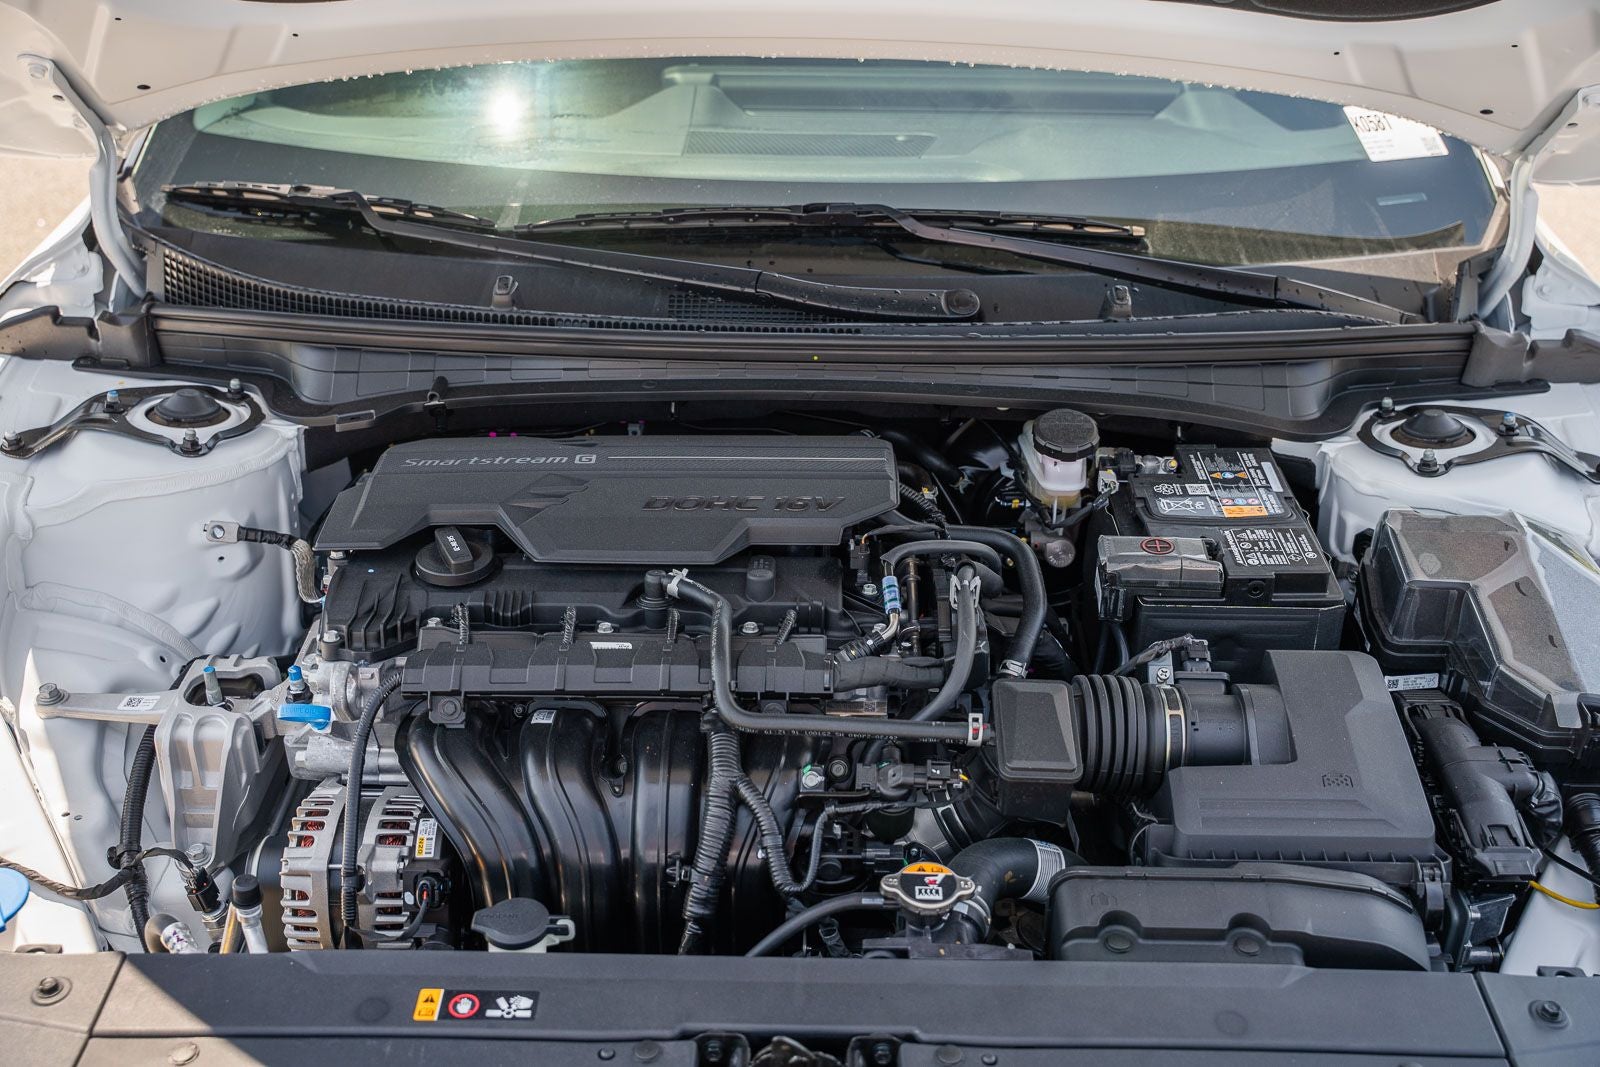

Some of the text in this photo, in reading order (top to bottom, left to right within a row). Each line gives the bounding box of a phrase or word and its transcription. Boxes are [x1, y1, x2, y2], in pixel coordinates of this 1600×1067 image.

[400, 455, 569, 467] Smartstream
[642, 495, 846, 512] DOHC 16V
